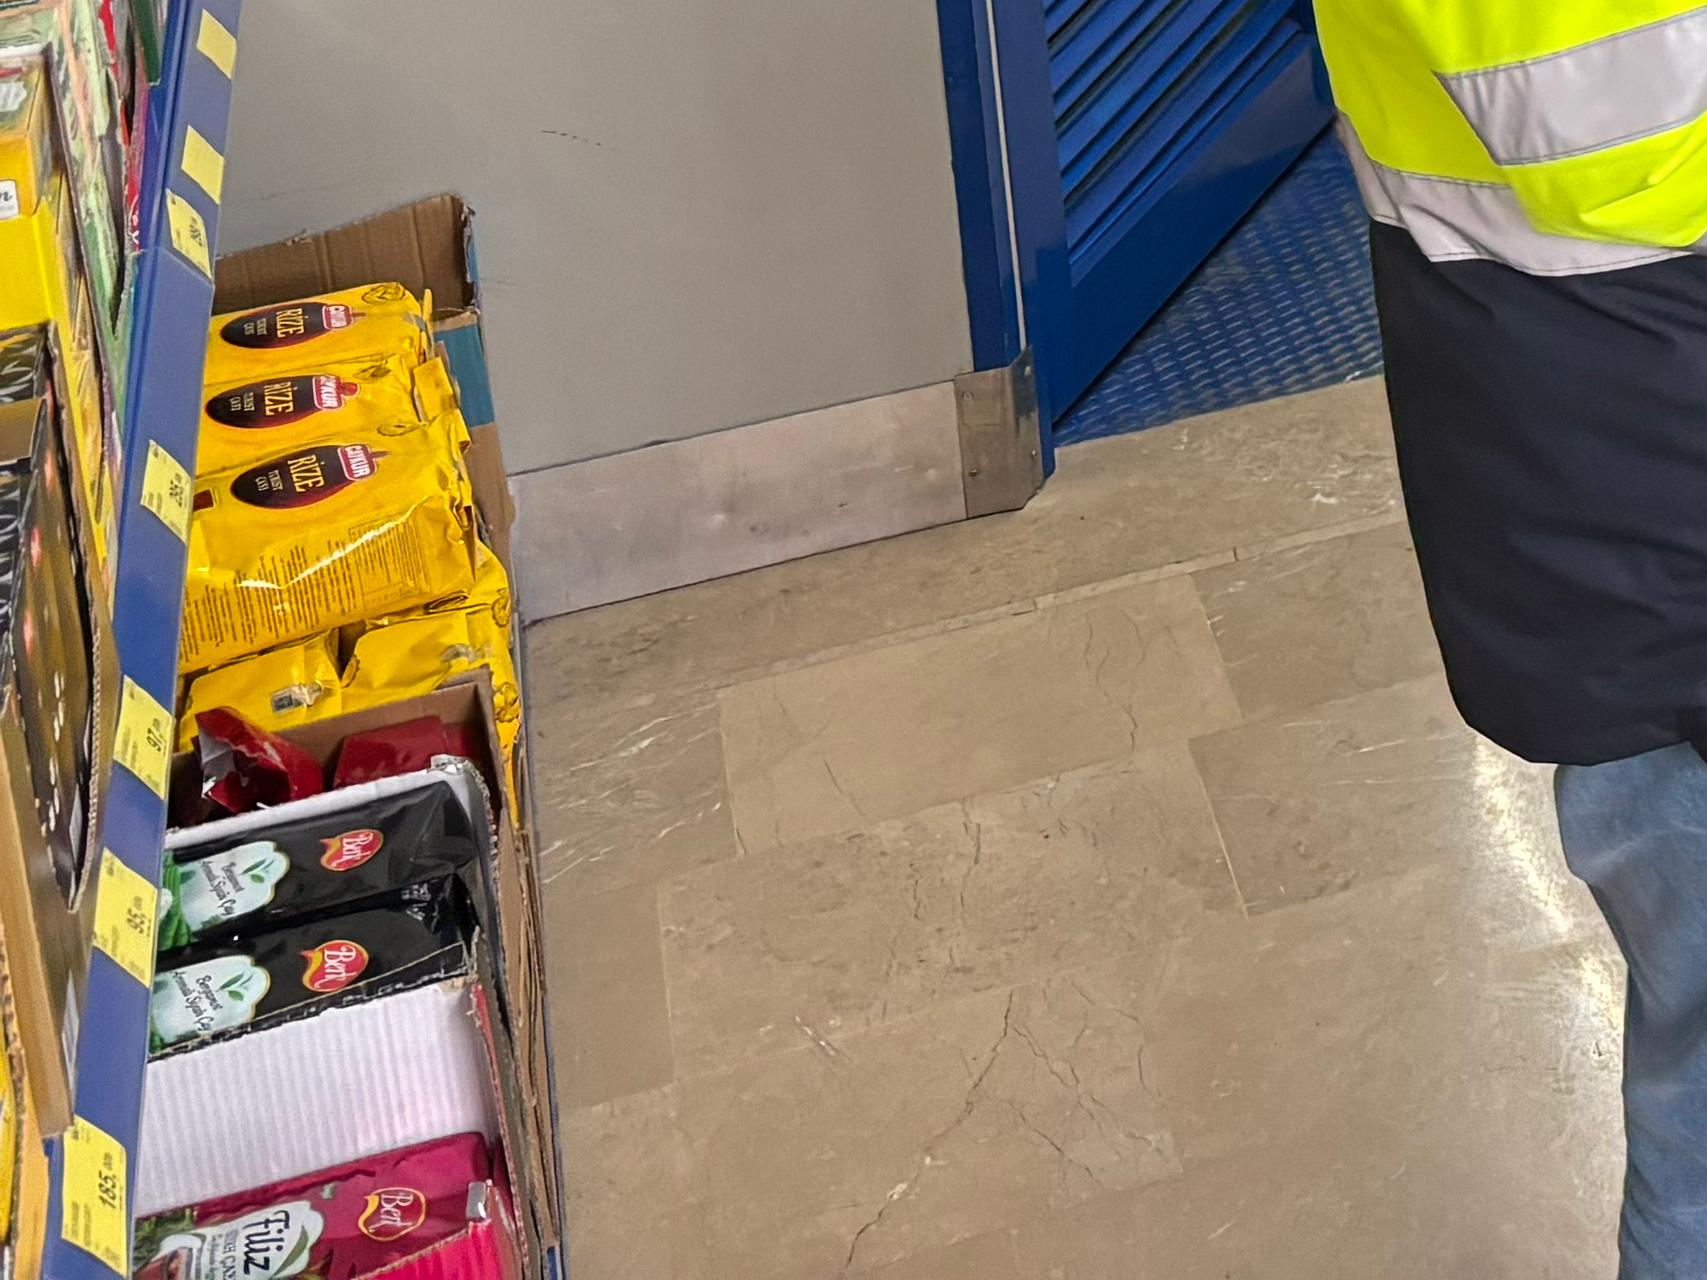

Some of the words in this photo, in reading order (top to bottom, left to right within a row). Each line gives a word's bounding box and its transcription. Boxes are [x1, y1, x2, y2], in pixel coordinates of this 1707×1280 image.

[276, 308, 309, 338] RİZE
[264, 383, 297, 416] RİZE
[287, 454, 324, 493] RİZE
[332, 832, 374, 868] Berk
[314, 946, 357, 989] Berk
[243, 1210, 290, 1275] Filiz
